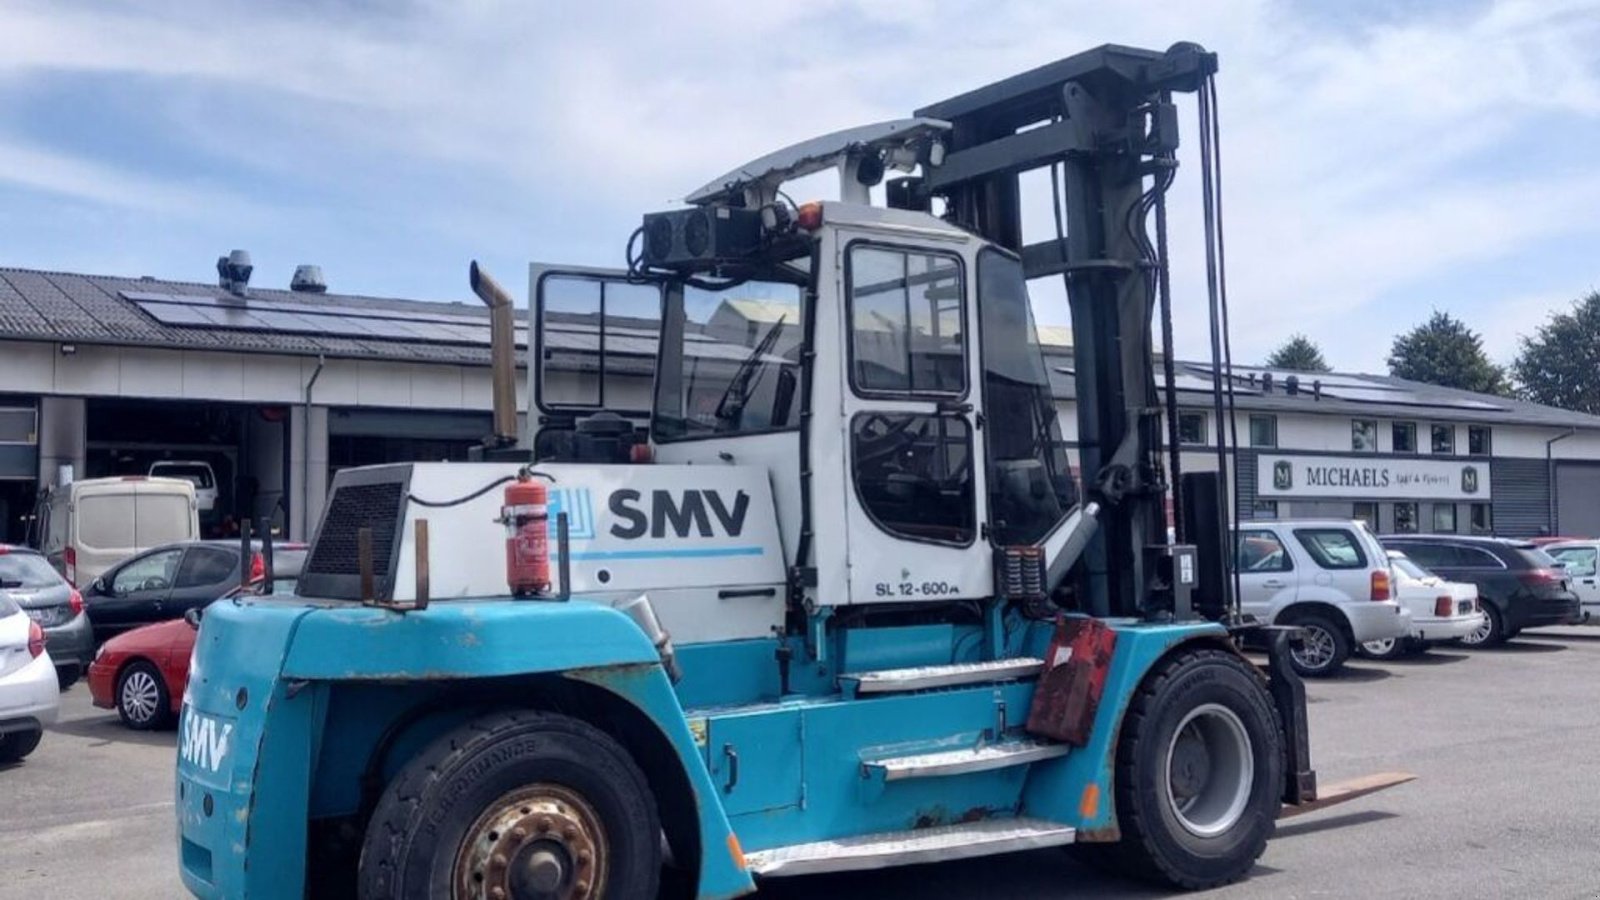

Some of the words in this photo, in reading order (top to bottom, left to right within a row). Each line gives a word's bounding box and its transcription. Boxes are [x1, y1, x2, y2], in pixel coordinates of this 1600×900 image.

[1306, 467, 1389, 487] MICHAELS
[608, 488, 750, 540] SMV
[875, 583, 895, 596] SL
[181, 706, 232, 773] SMV
